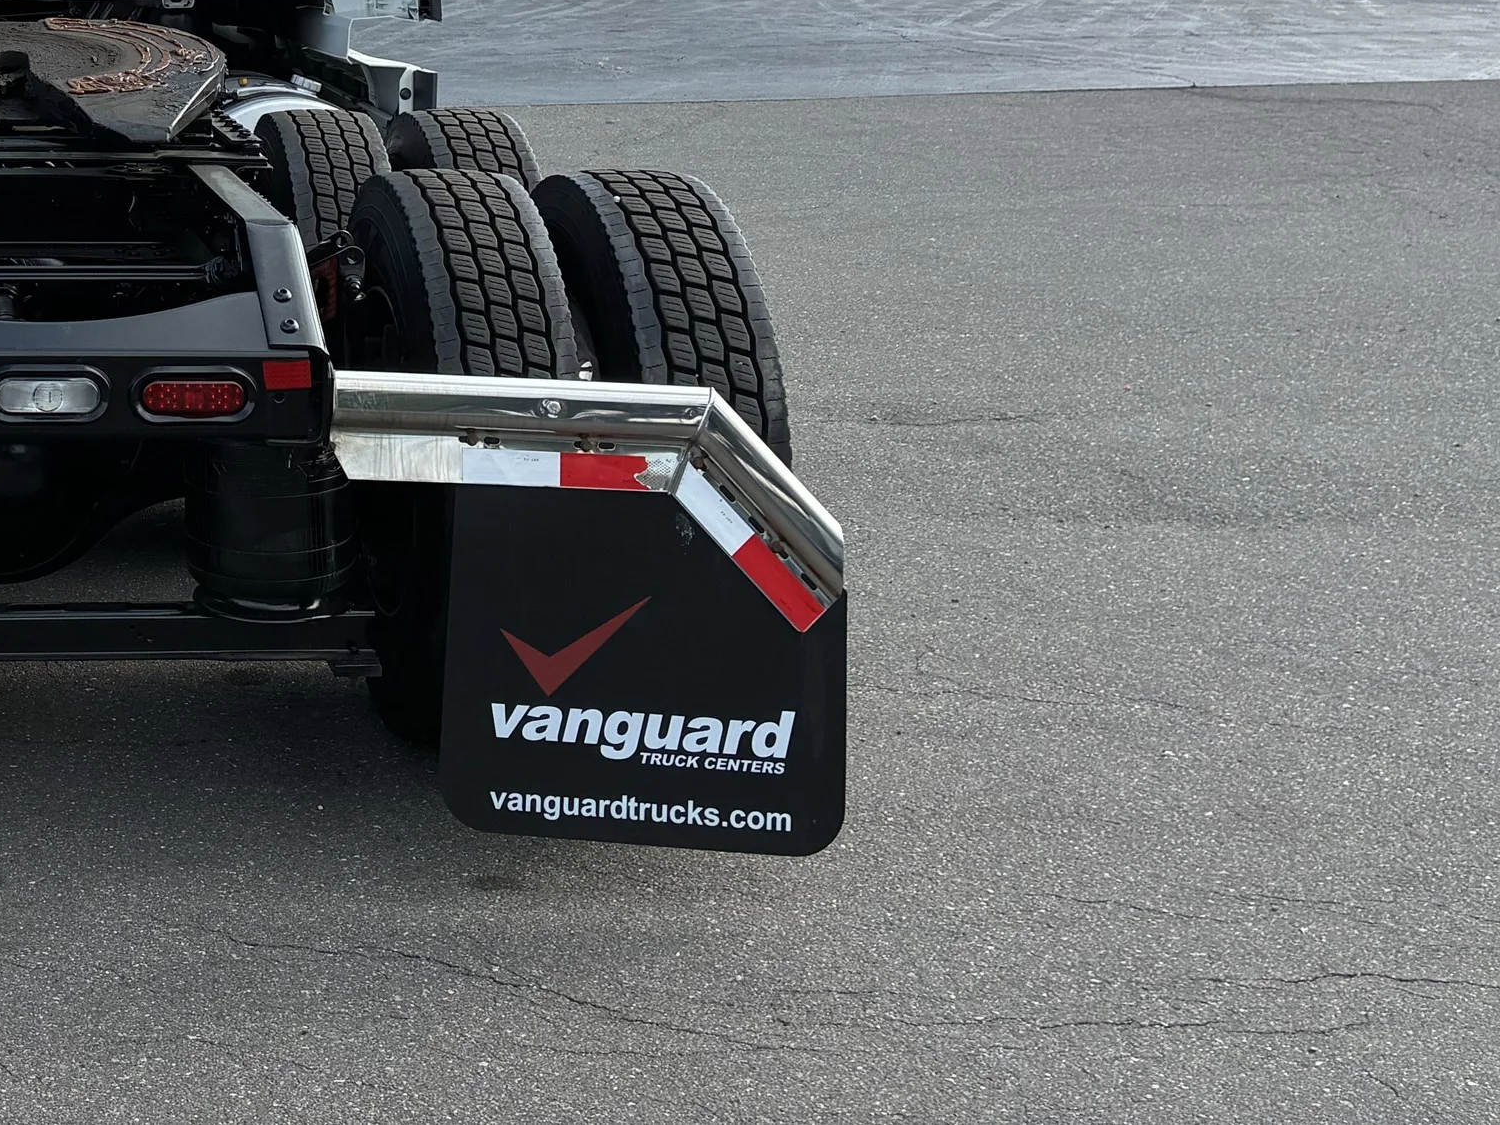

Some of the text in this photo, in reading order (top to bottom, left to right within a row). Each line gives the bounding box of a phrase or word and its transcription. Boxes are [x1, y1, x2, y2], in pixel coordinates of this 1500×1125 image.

[491, 702, 796, 760] vanguard
[639, 751, 786, 775] TRUCK CENTERS
[489, 791, 792, 832] vanguardtrucks.com
